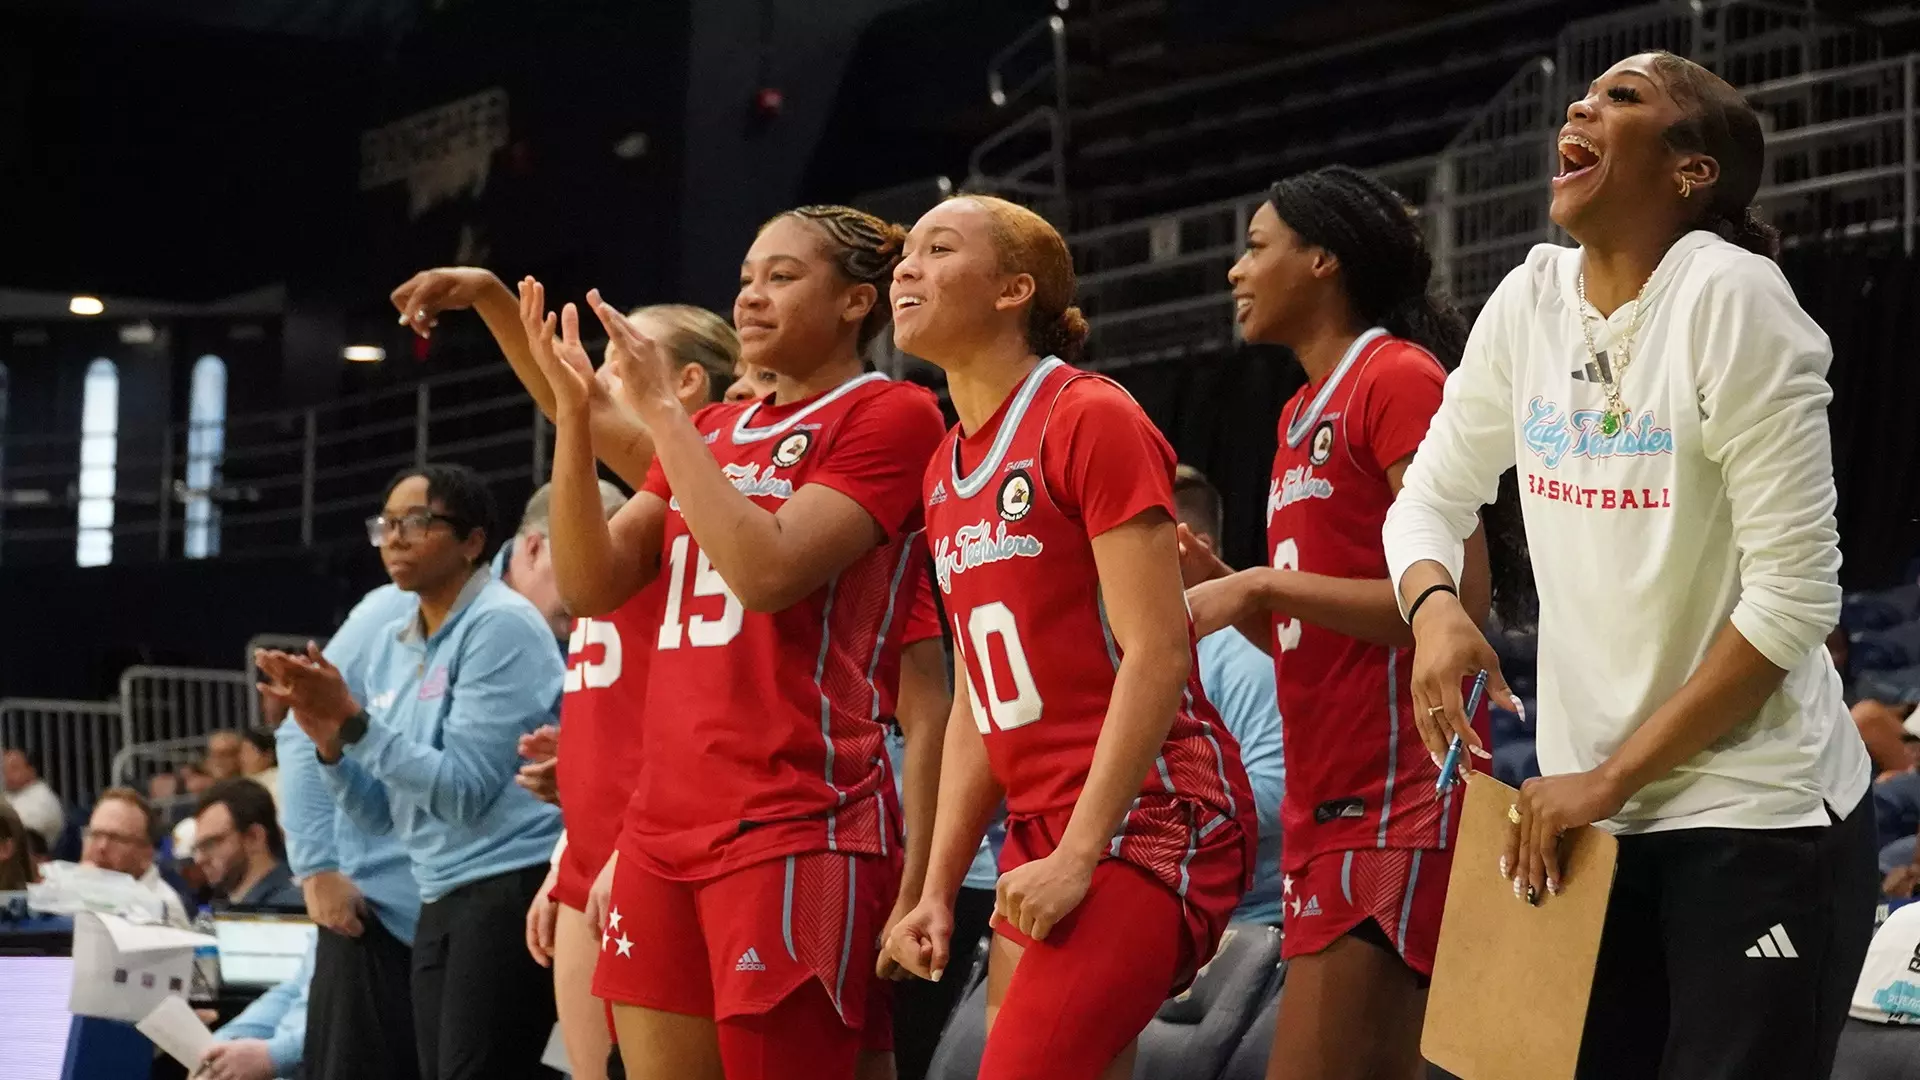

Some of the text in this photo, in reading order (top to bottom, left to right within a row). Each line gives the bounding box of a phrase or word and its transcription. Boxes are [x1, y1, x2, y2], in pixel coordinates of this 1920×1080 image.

[1523, 394, 1674, 470] Lady Techster
[658, 534, 744, 650] 15
[954, 600, 1044, 735] 10
